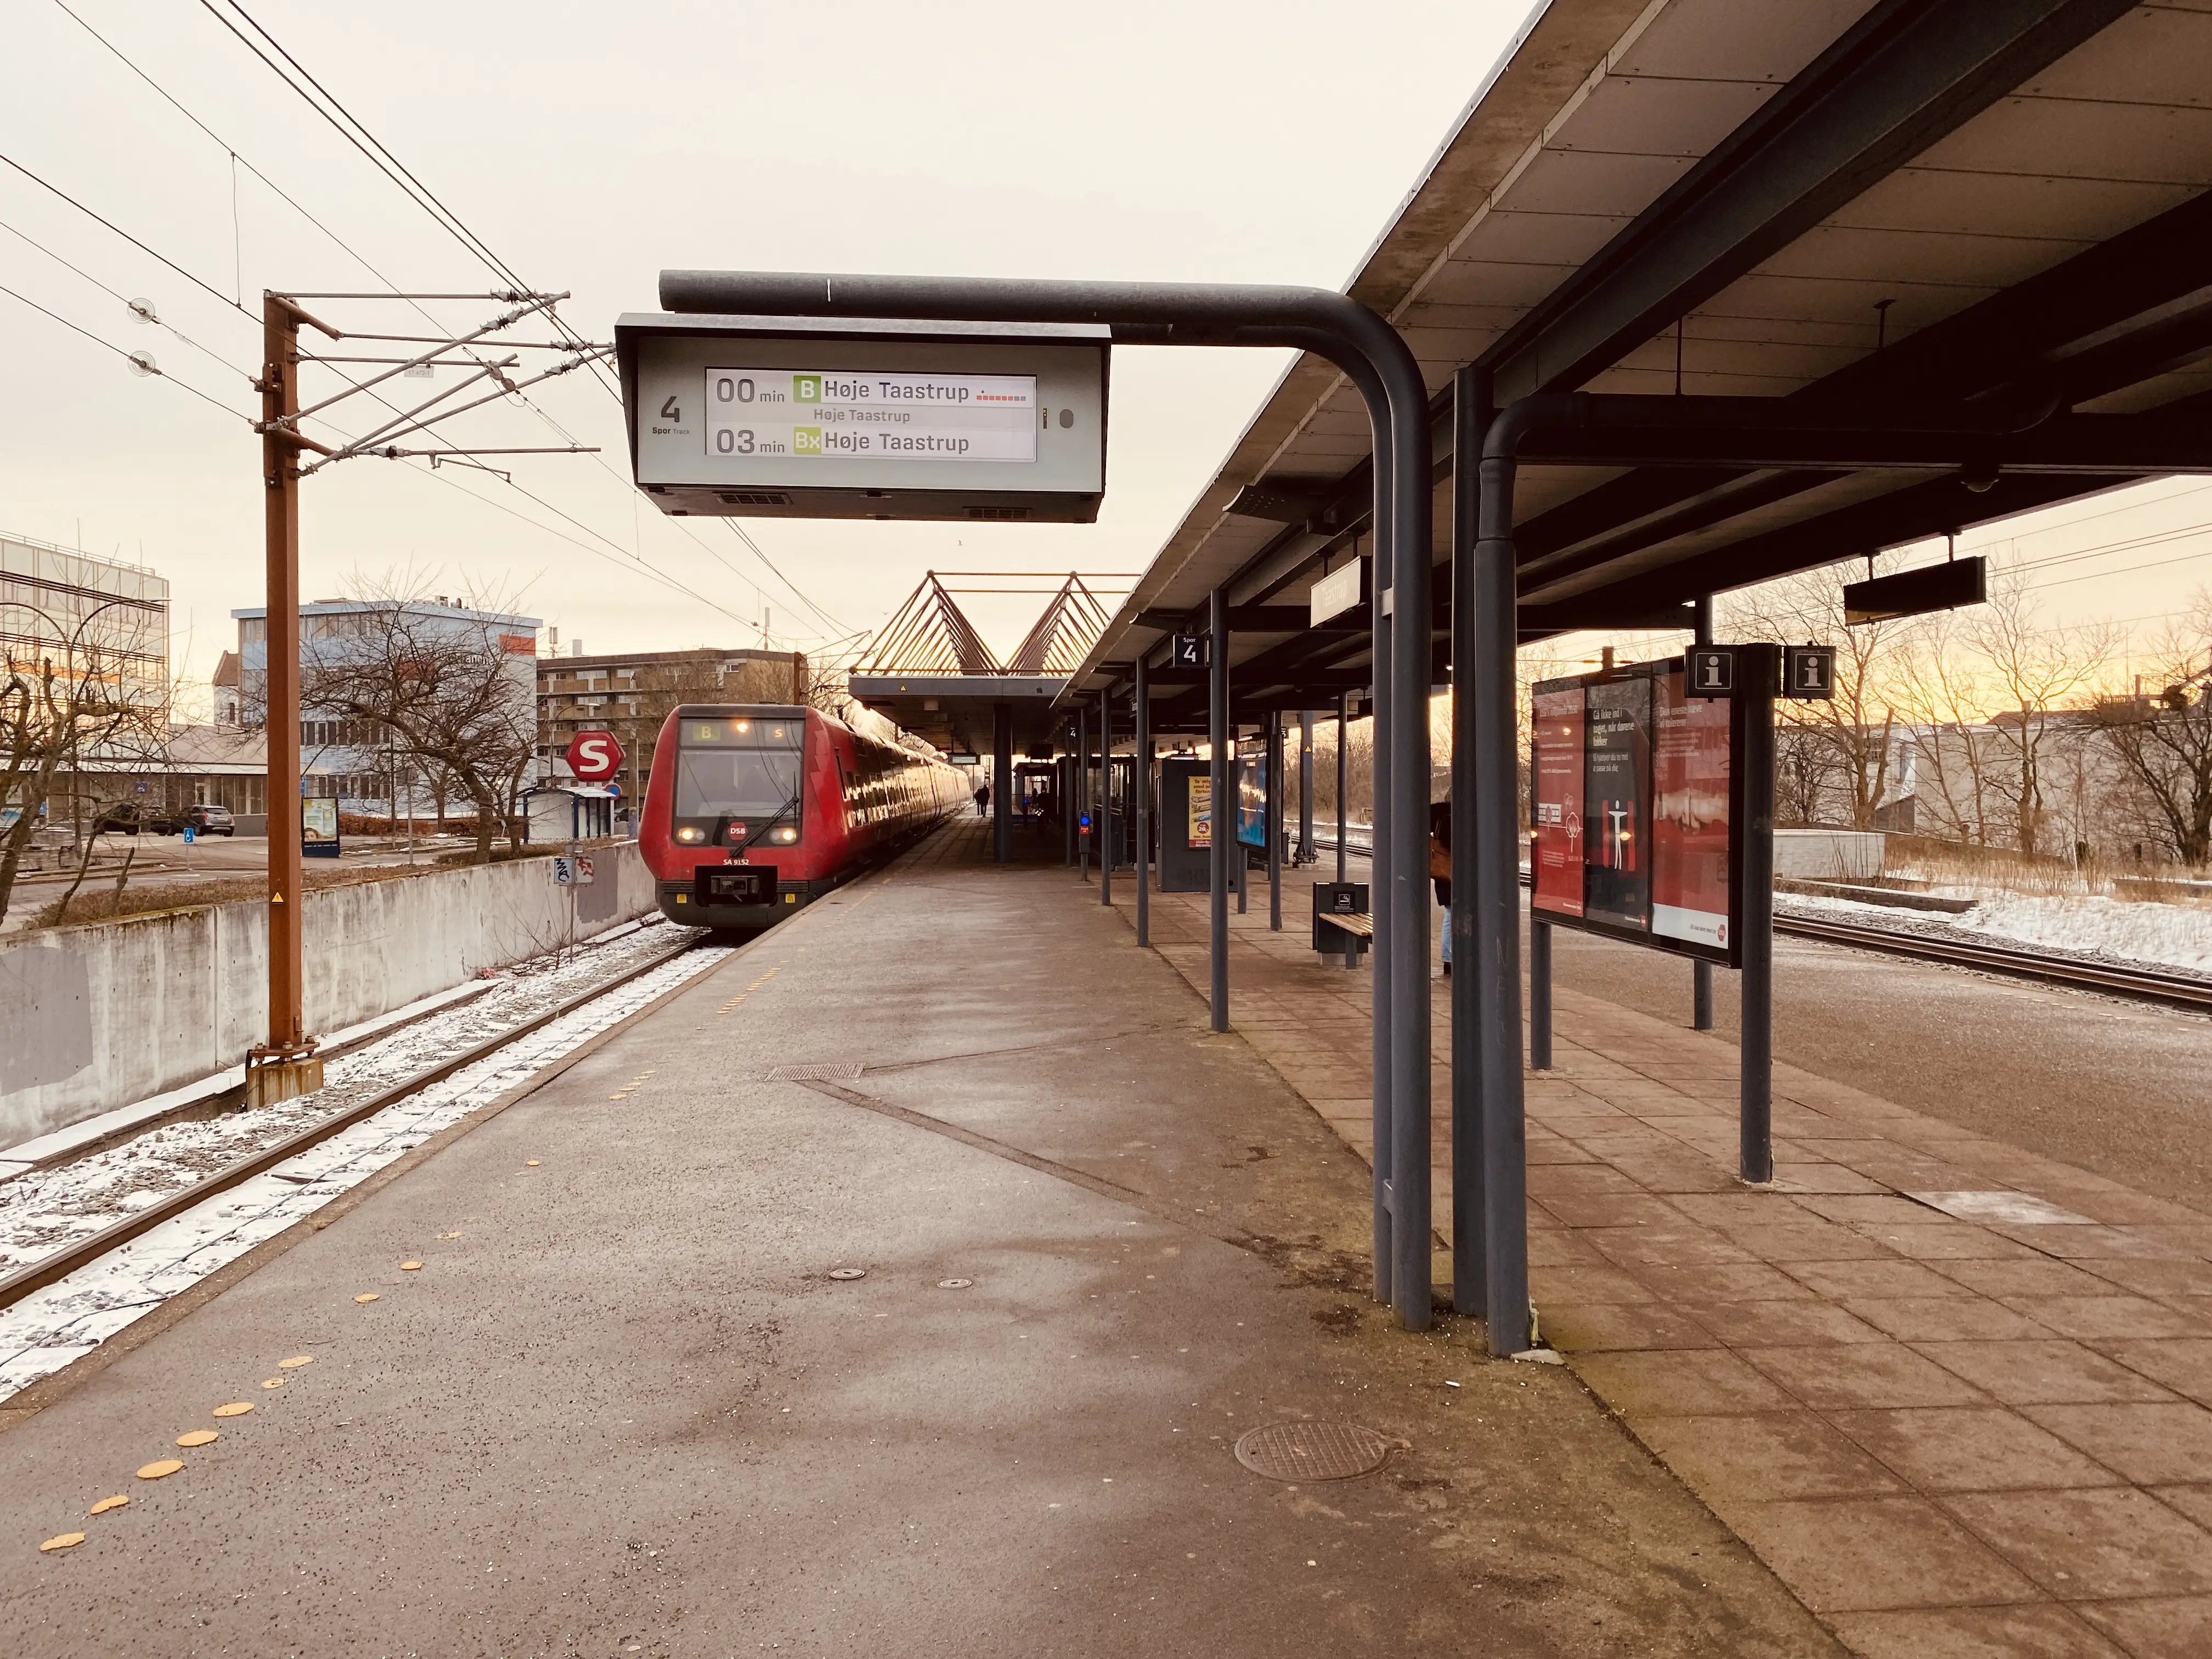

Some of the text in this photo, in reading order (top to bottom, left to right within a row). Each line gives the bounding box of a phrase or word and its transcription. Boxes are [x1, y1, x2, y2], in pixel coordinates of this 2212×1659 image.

[716, 378, 969, 404] 00 min B Høje Taastrup
[661, 396, 680, 422] 4
[814, 408, 911, 425] Høje Taastrup
[652, 427, 671, 435] Spor
[716, 429, 969, 455] 03 min Bx Høje Taastrup
[1322, 579, 1347, 608] Taastrup
[1183, 645, 1196, 662] 4
[701, 726, 712, 739] B
[578, 740, 610, 772] S
